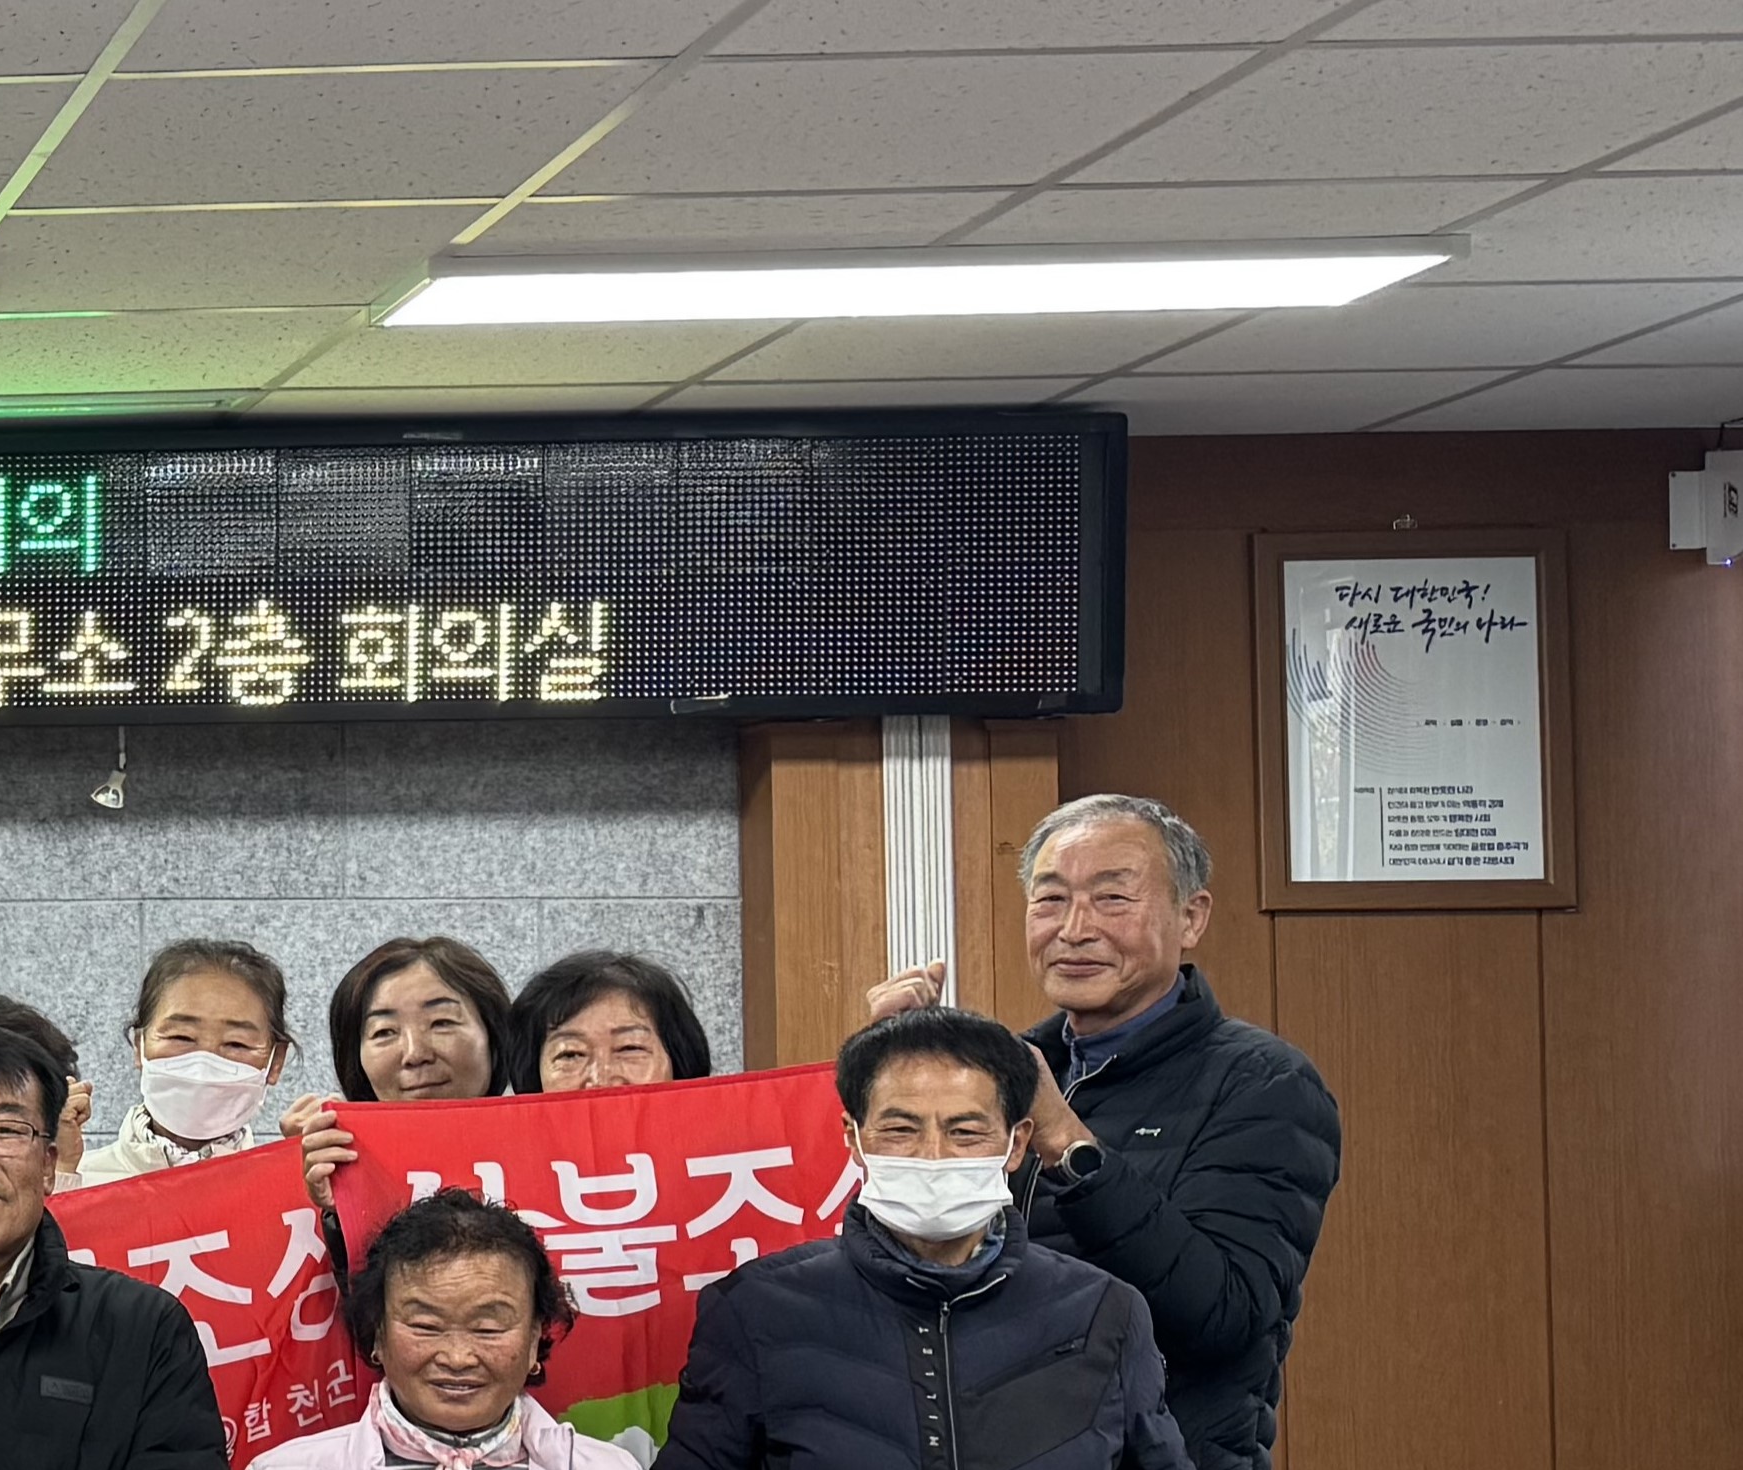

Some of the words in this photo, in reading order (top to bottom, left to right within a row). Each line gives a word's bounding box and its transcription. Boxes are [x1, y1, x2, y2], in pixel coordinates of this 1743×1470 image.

[1334, 582, 1382, 608] 다시
[1389, 578, 1491, 609] 대한민국!
[1344, 612, 1404, 645] 새로운
[1411, 608, 1470, 653] 국민의
[1475, 609, 1528, 644] 나라
[165, 600, 311, 706] 2층
[340, 600, 605, 703] 회의실
[406, 1133, 865, 1317] 불조
[243, 1359, 357, 1443] 합천군
[918, 1326, 939, 1446] MILLET
